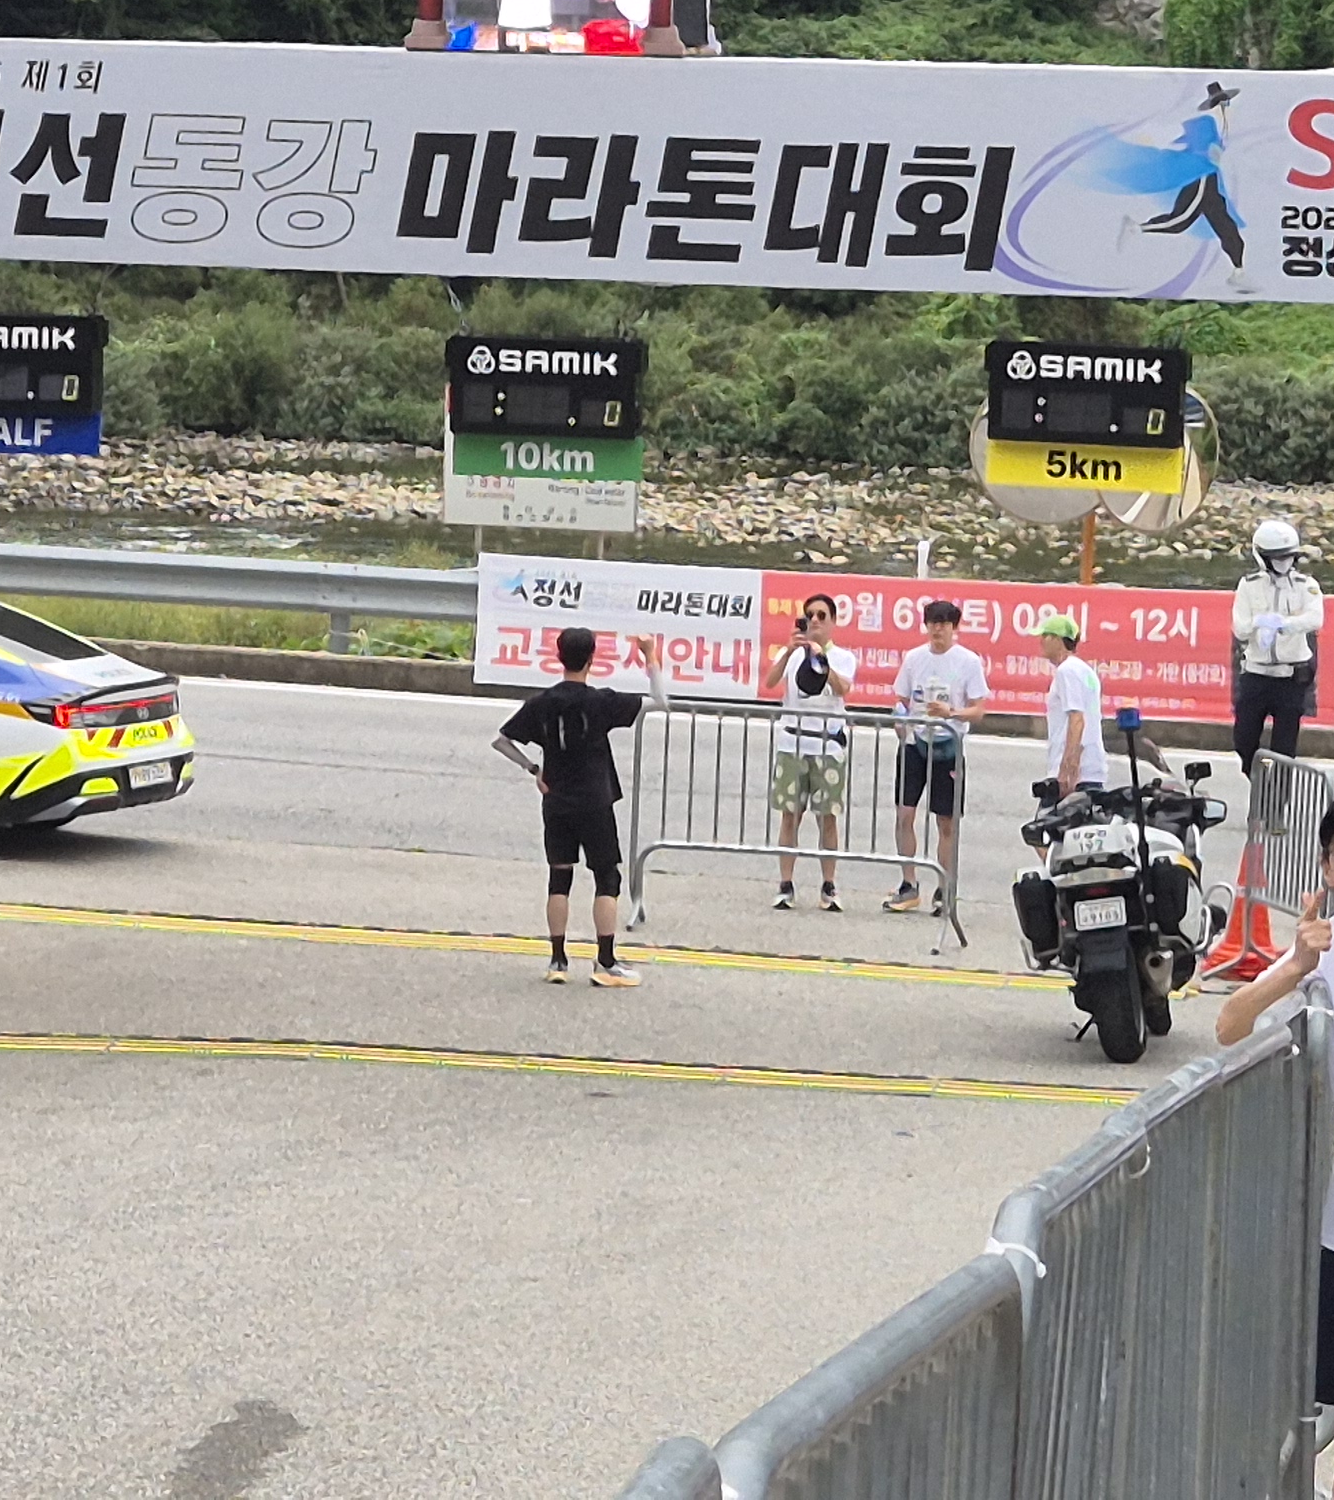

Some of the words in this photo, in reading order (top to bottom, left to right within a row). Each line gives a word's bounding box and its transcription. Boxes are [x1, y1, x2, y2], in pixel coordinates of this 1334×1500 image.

[20, 59, 105, 95] 제1회
[396, 129, 1016, 272] 마라톤대회
[498, 348, 618, 376] SAMIK
[1039, 354, 1164, 385] SAMIK
[499, 440, 596, 474] 10km
[1045, 450, 1124, 483] 5km
[531, 577, 583, 610] 정선
[635, 589, 754, 620] 마라톤대회
[834, 591, 884, 634] 9월
[1129, 605, 1200, 648] 12시
